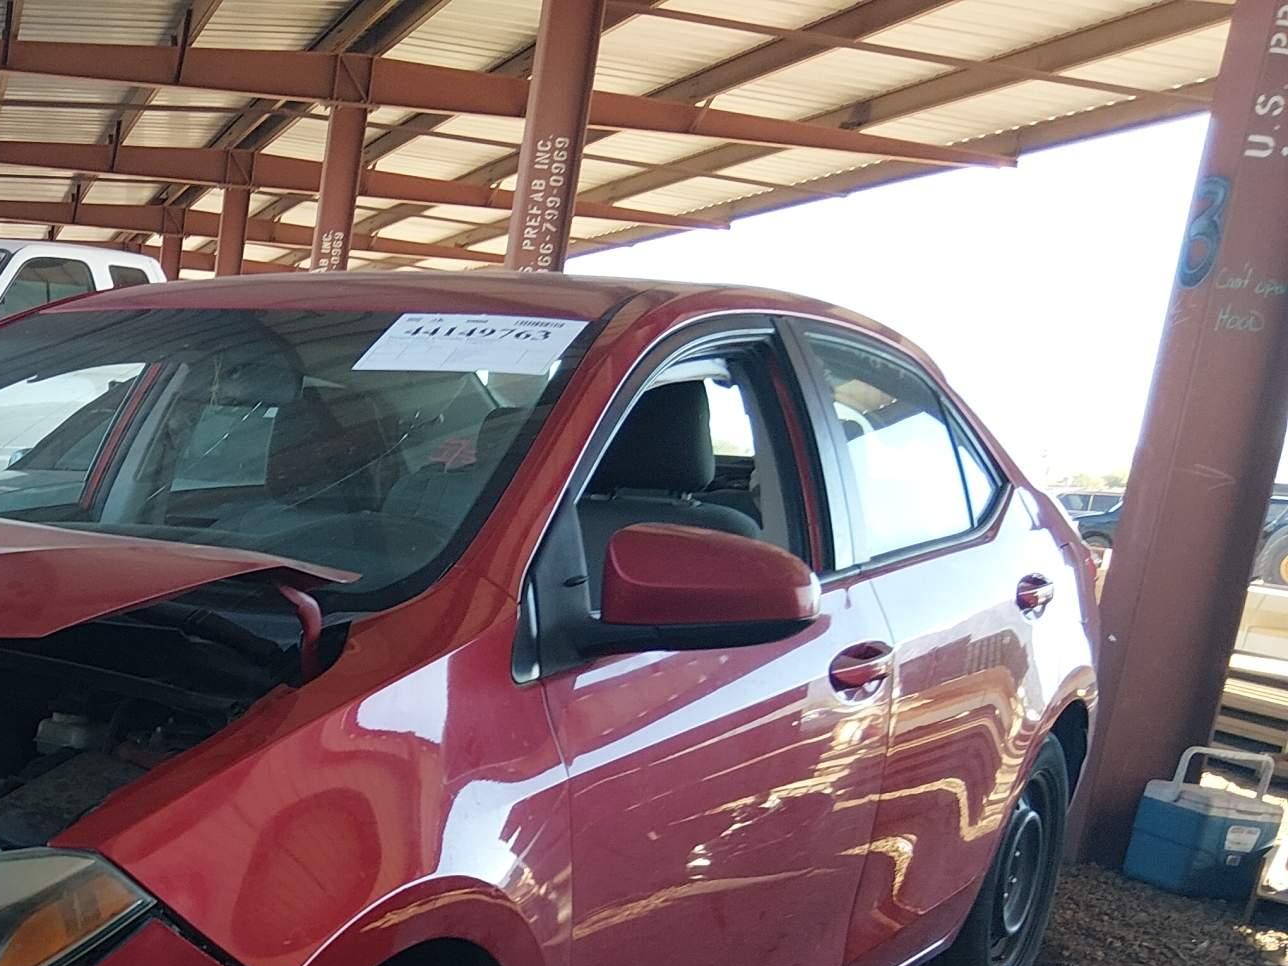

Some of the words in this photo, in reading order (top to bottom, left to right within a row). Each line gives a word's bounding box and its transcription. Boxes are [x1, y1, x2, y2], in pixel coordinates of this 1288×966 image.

[522, 179, 546, 250] PREFAB
[534, 134, 554, 170] INC.
[404, 326, 552, 341] 44149763
